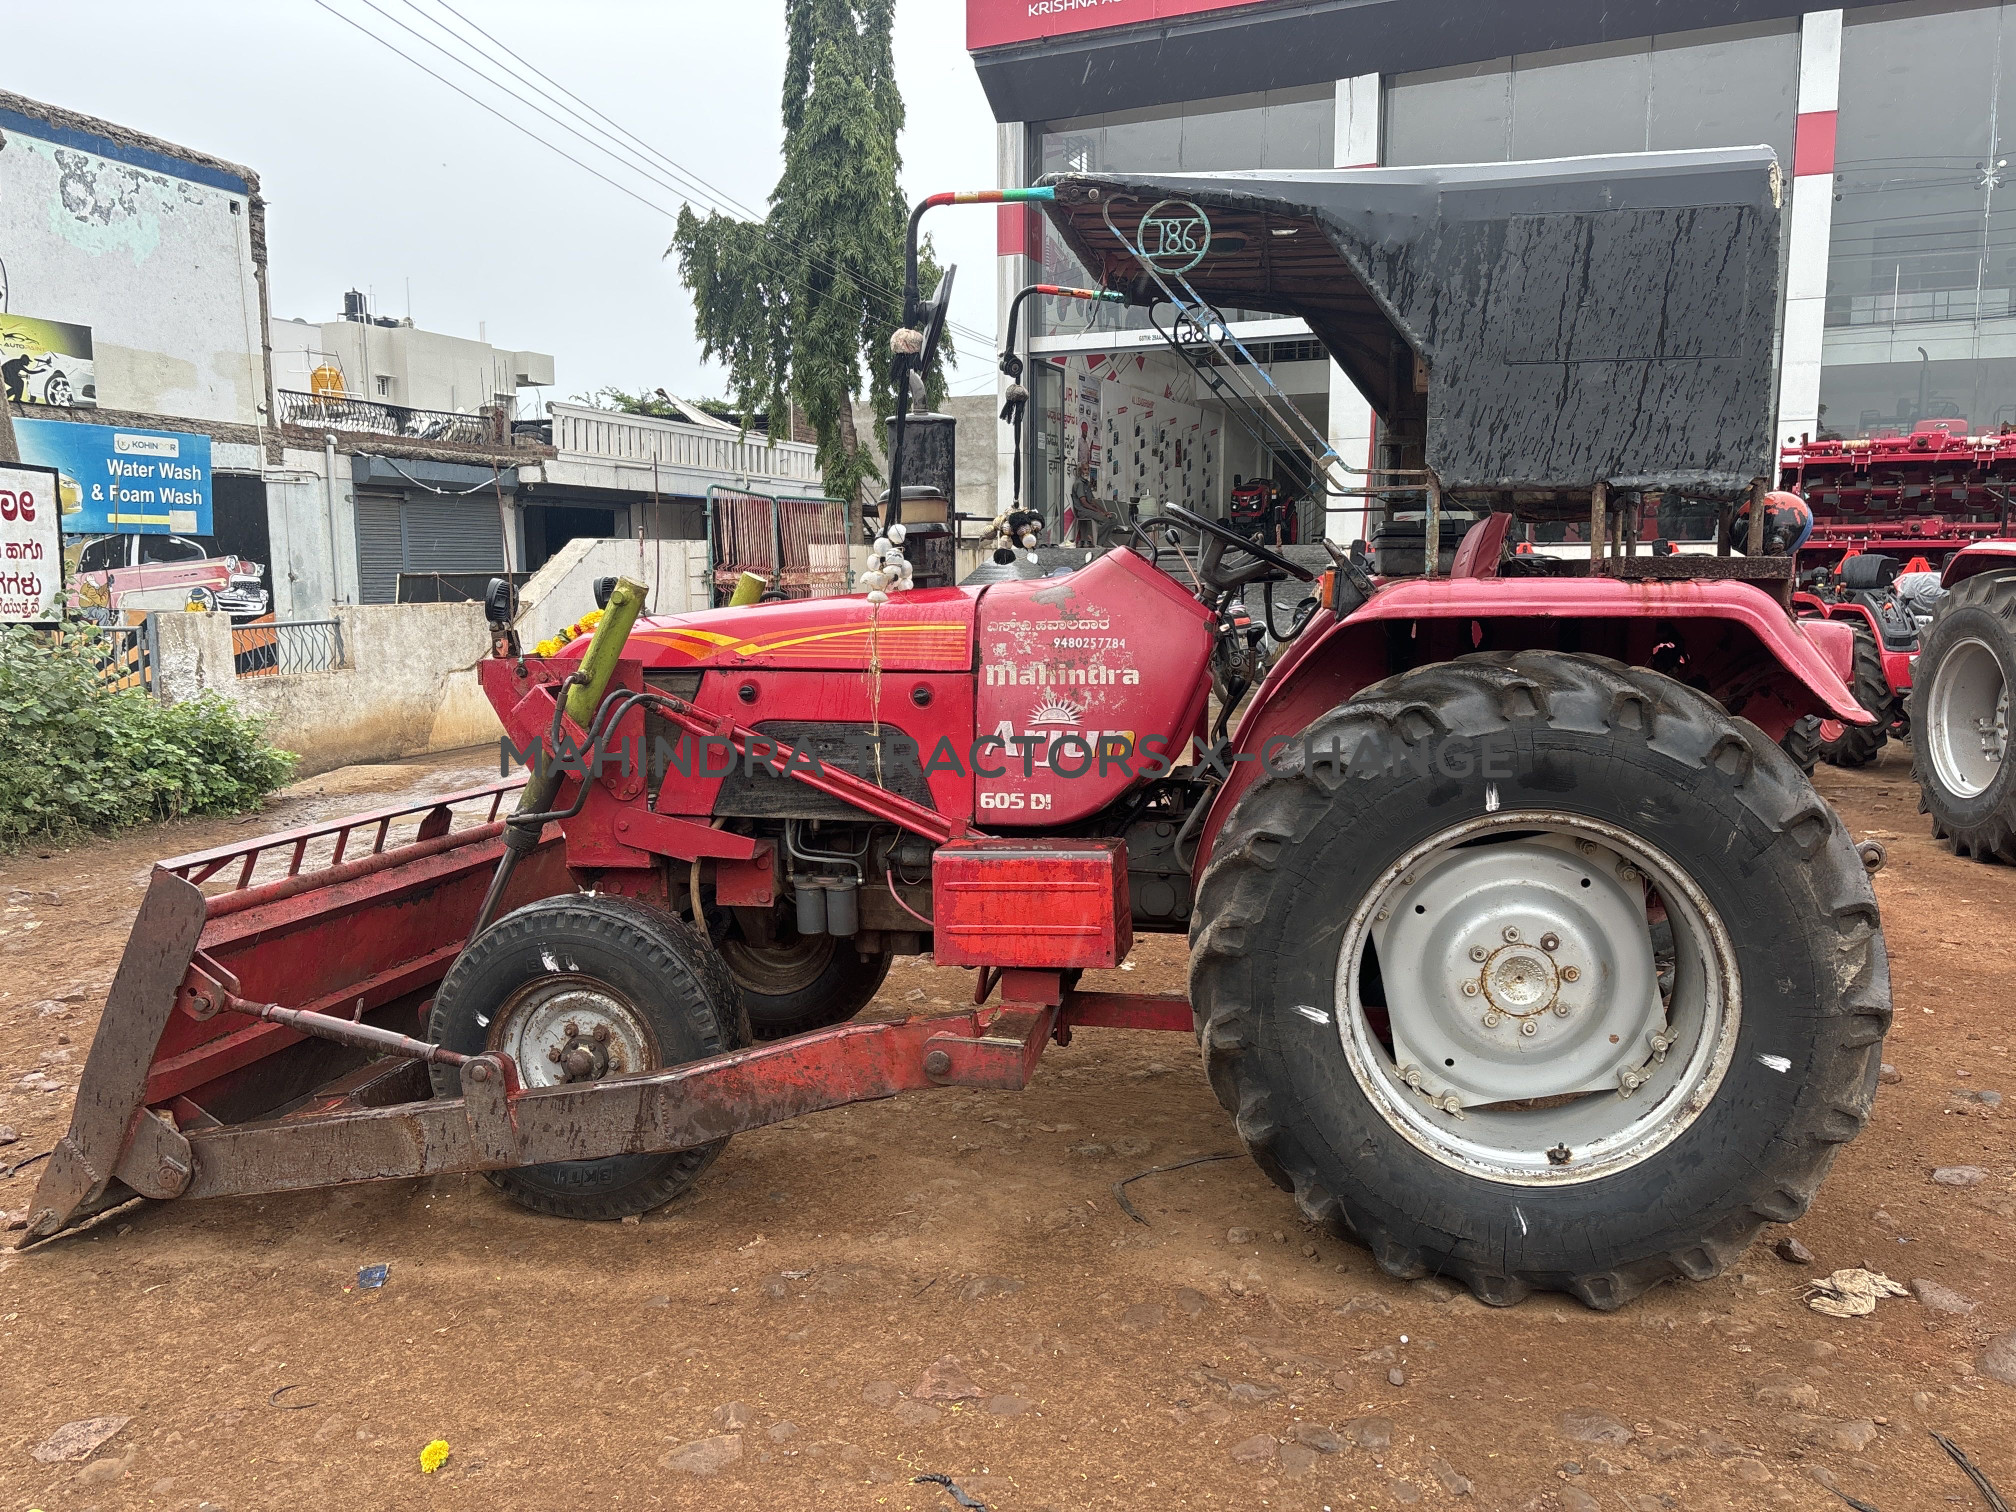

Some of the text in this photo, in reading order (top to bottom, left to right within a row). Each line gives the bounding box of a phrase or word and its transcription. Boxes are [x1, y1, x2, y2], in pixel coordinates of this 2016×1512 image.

[106, 458, 202, 480] Water Wash
[91, 483, 203, 505] & Foam Wash
[1053, 637, 1126, 649] 9480257784
[985, 663, 1140, 686] Mahindra
[980, 792, 1025, 810] 605
